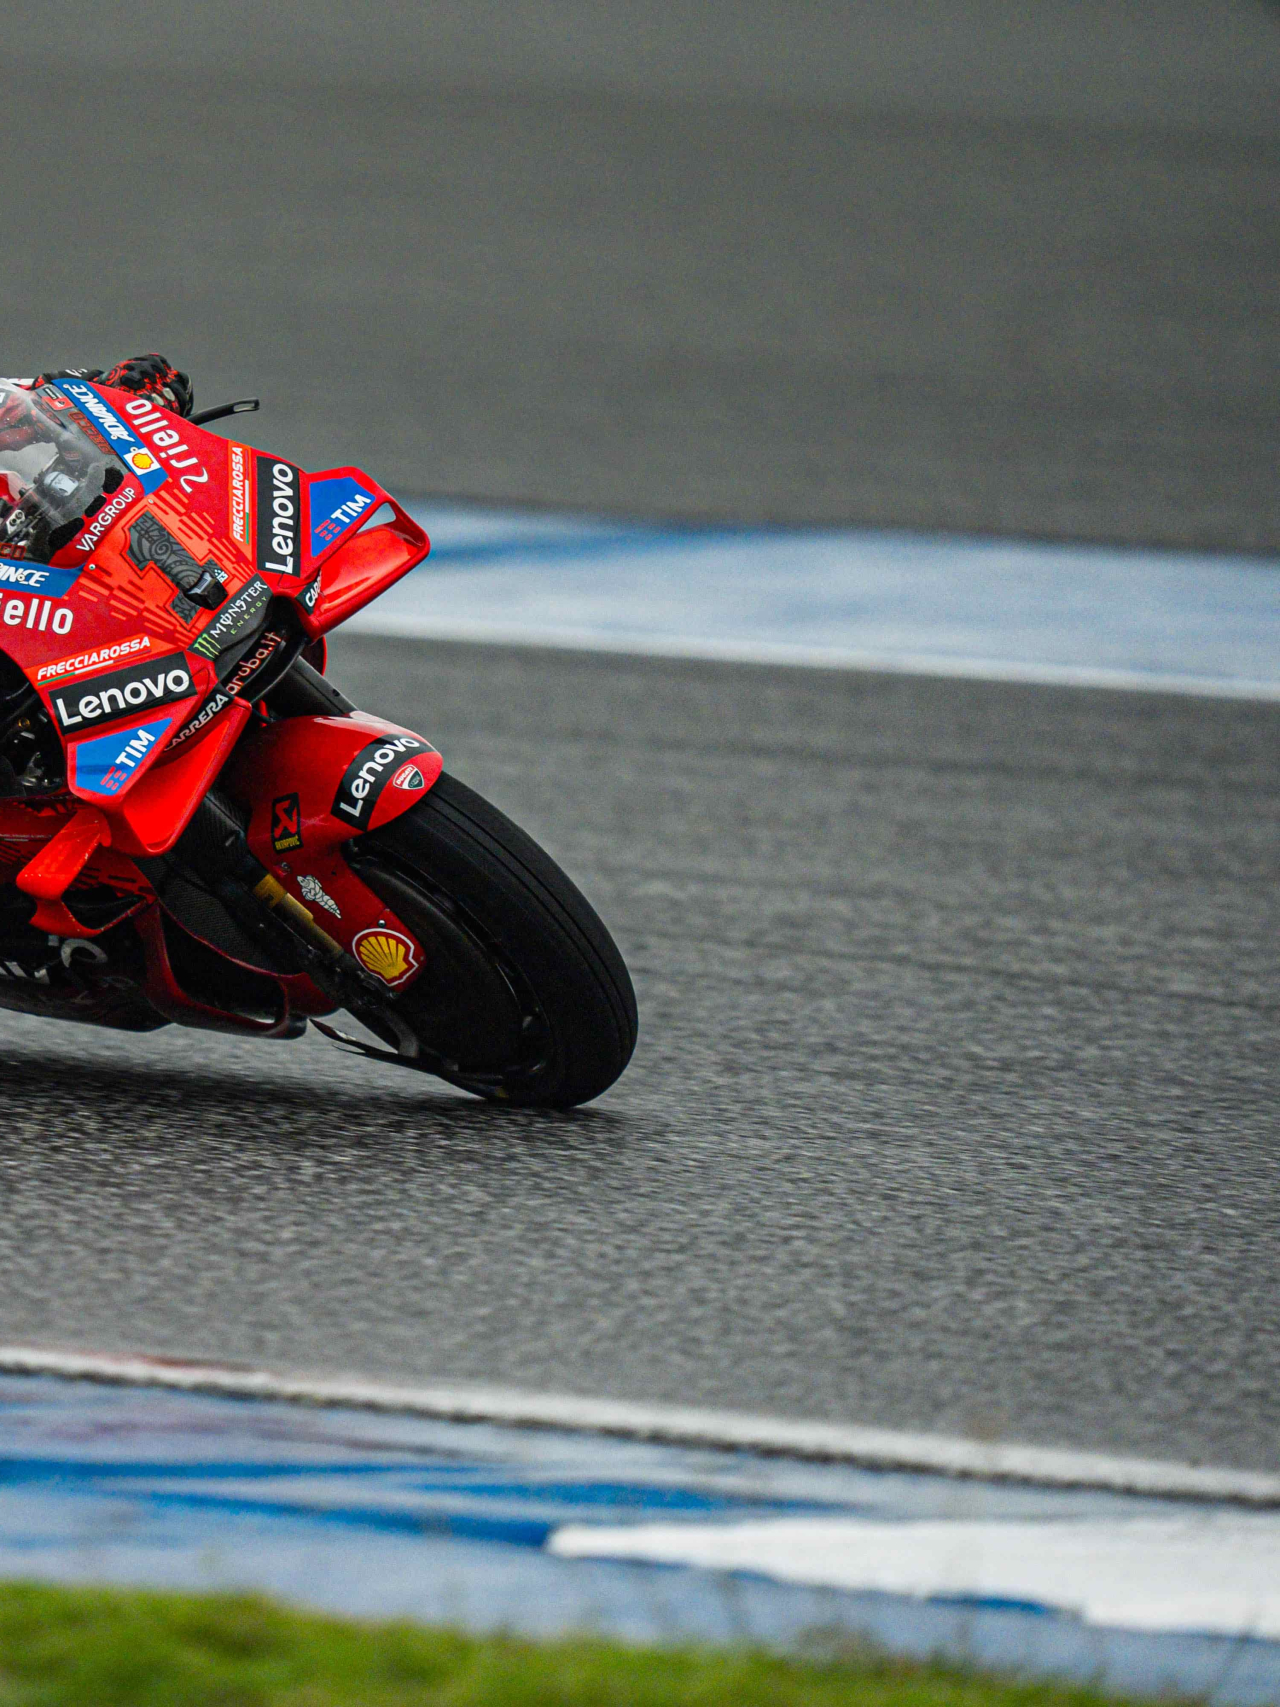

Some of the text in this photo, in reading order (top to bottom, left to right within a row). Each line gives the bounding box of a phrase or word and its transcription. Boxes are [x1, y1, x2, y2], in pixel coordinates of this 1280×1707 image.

[68, 384, 135, 443] ADVANCE
[125, 398, 199, 474] riello
[76, 486, 137, 553] VARGROUP
[232, 445, 245, 543] FRECCIAROSSA
[264, 462, 296, 575] Lenovo
[330, 493, 372, 525] TIM
[209, 579, 268, 638] MONSTER
[230, 596, 268, 635] ENERGY
[37, 636, 151, 681] FRECCIAROSSA
[225, 631, 283, 695] aruba.it
[56, 668, 190, 727] Lenovo
[115, 728, 156, 768] TIM
[339, 736, 420, 818] Lenovo
